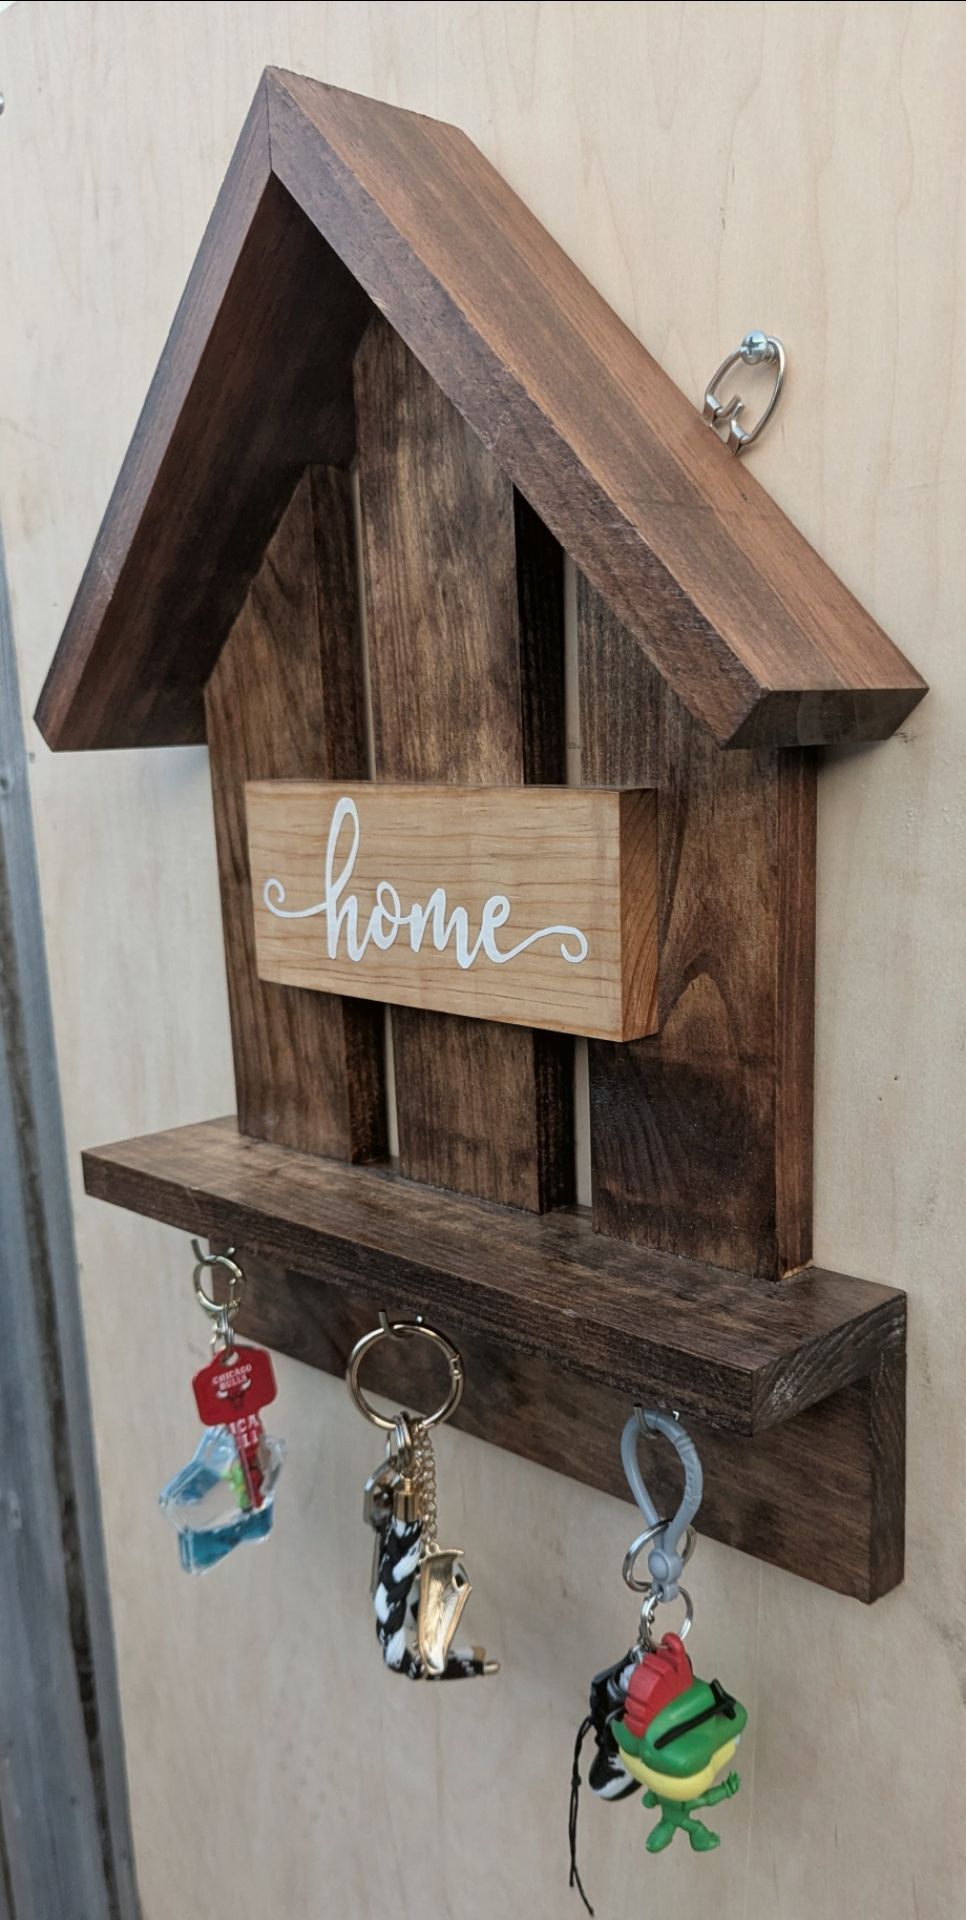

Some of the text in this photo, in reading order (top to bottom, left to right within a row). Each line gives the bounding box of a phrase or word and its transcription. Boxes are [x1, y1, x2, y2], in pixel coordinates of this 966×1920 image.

[263, 796, 588, 969] home
[211, 1363, 252, 1385] CHICAGO
[219, 1373, 247, 1391] BULLS
